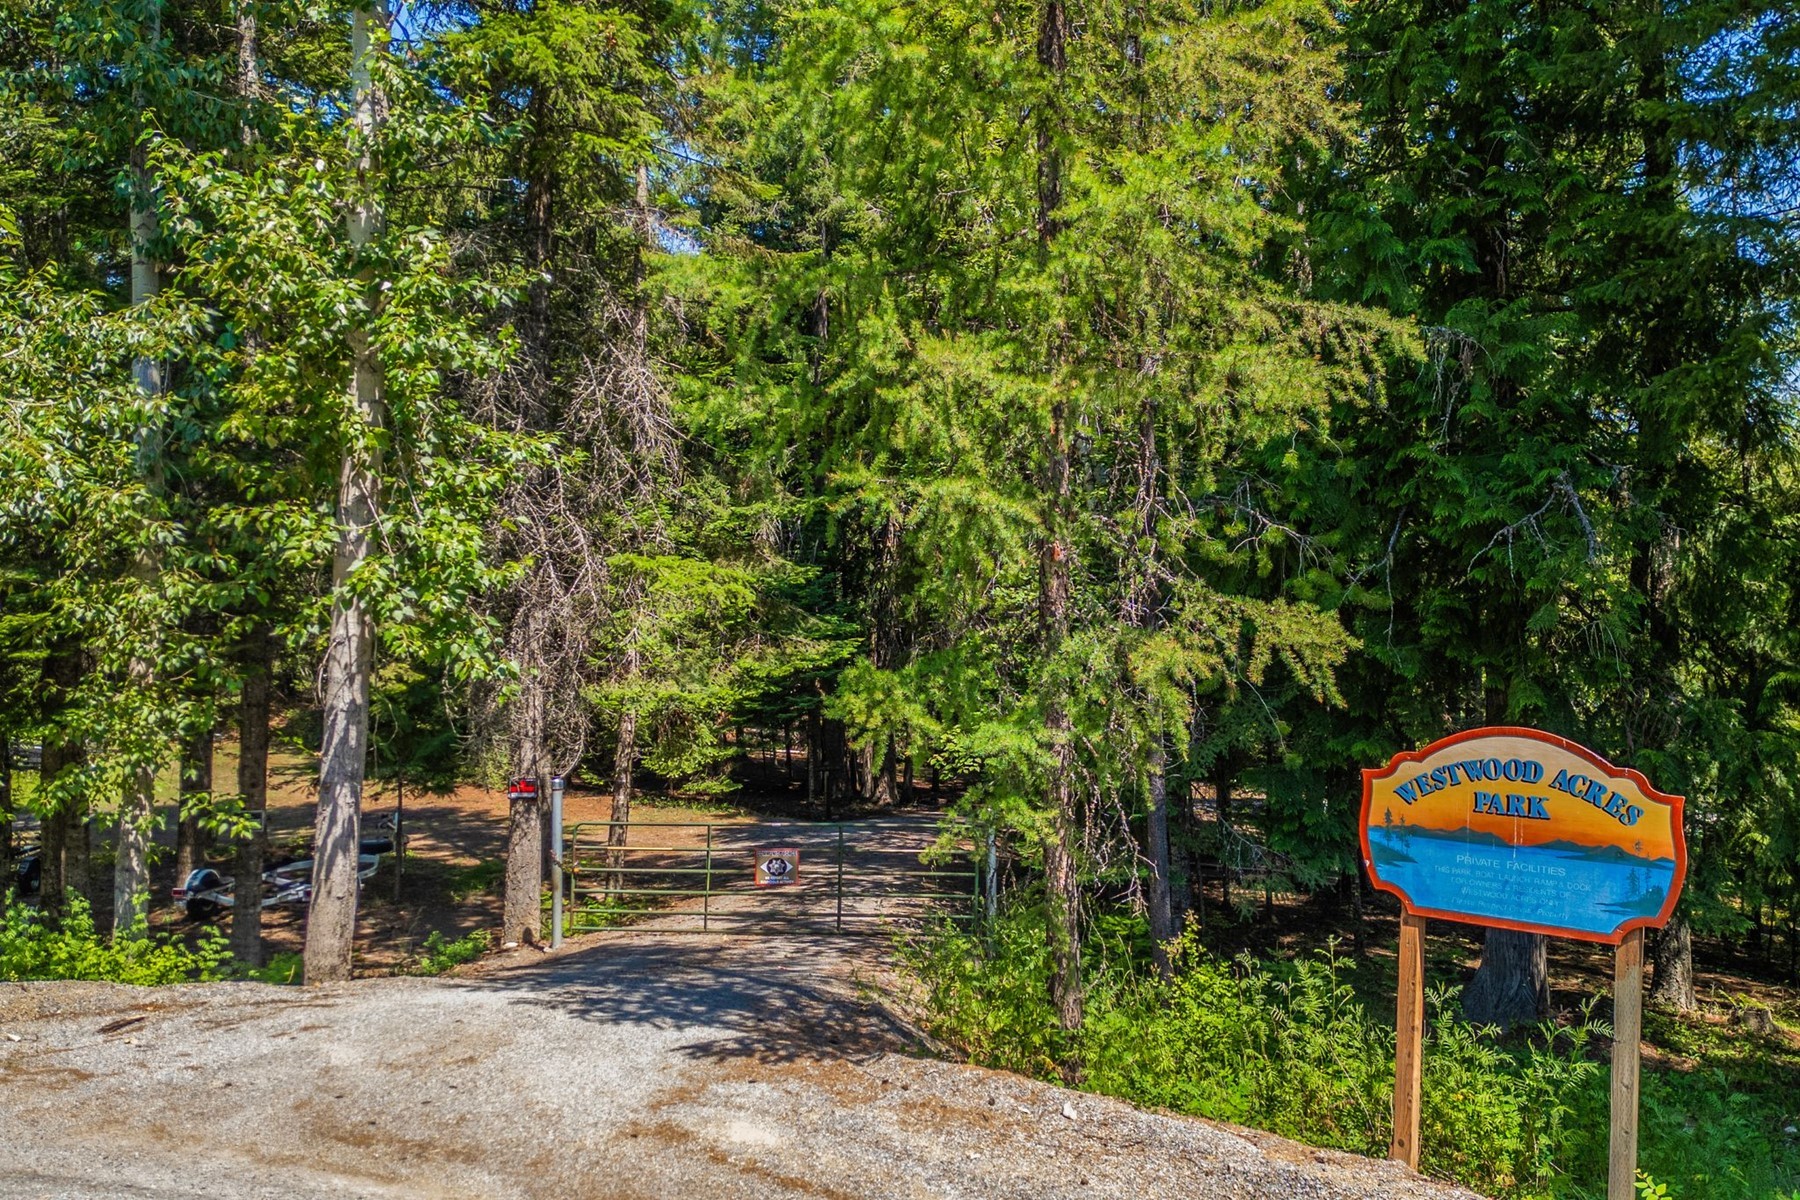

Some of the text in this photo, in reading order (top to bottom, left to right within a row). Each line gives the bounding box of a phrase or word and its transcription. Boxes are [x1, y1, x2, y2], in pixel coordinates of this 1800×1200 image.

[1394, 758, 1645, 826] WESTWOOD ACRES
[1473, 791, 1551, 820] PARK
[1456, 854, 1566, 877] PRIVATE FACILITIES
[1567, 881, 1592, 892] DOCK
